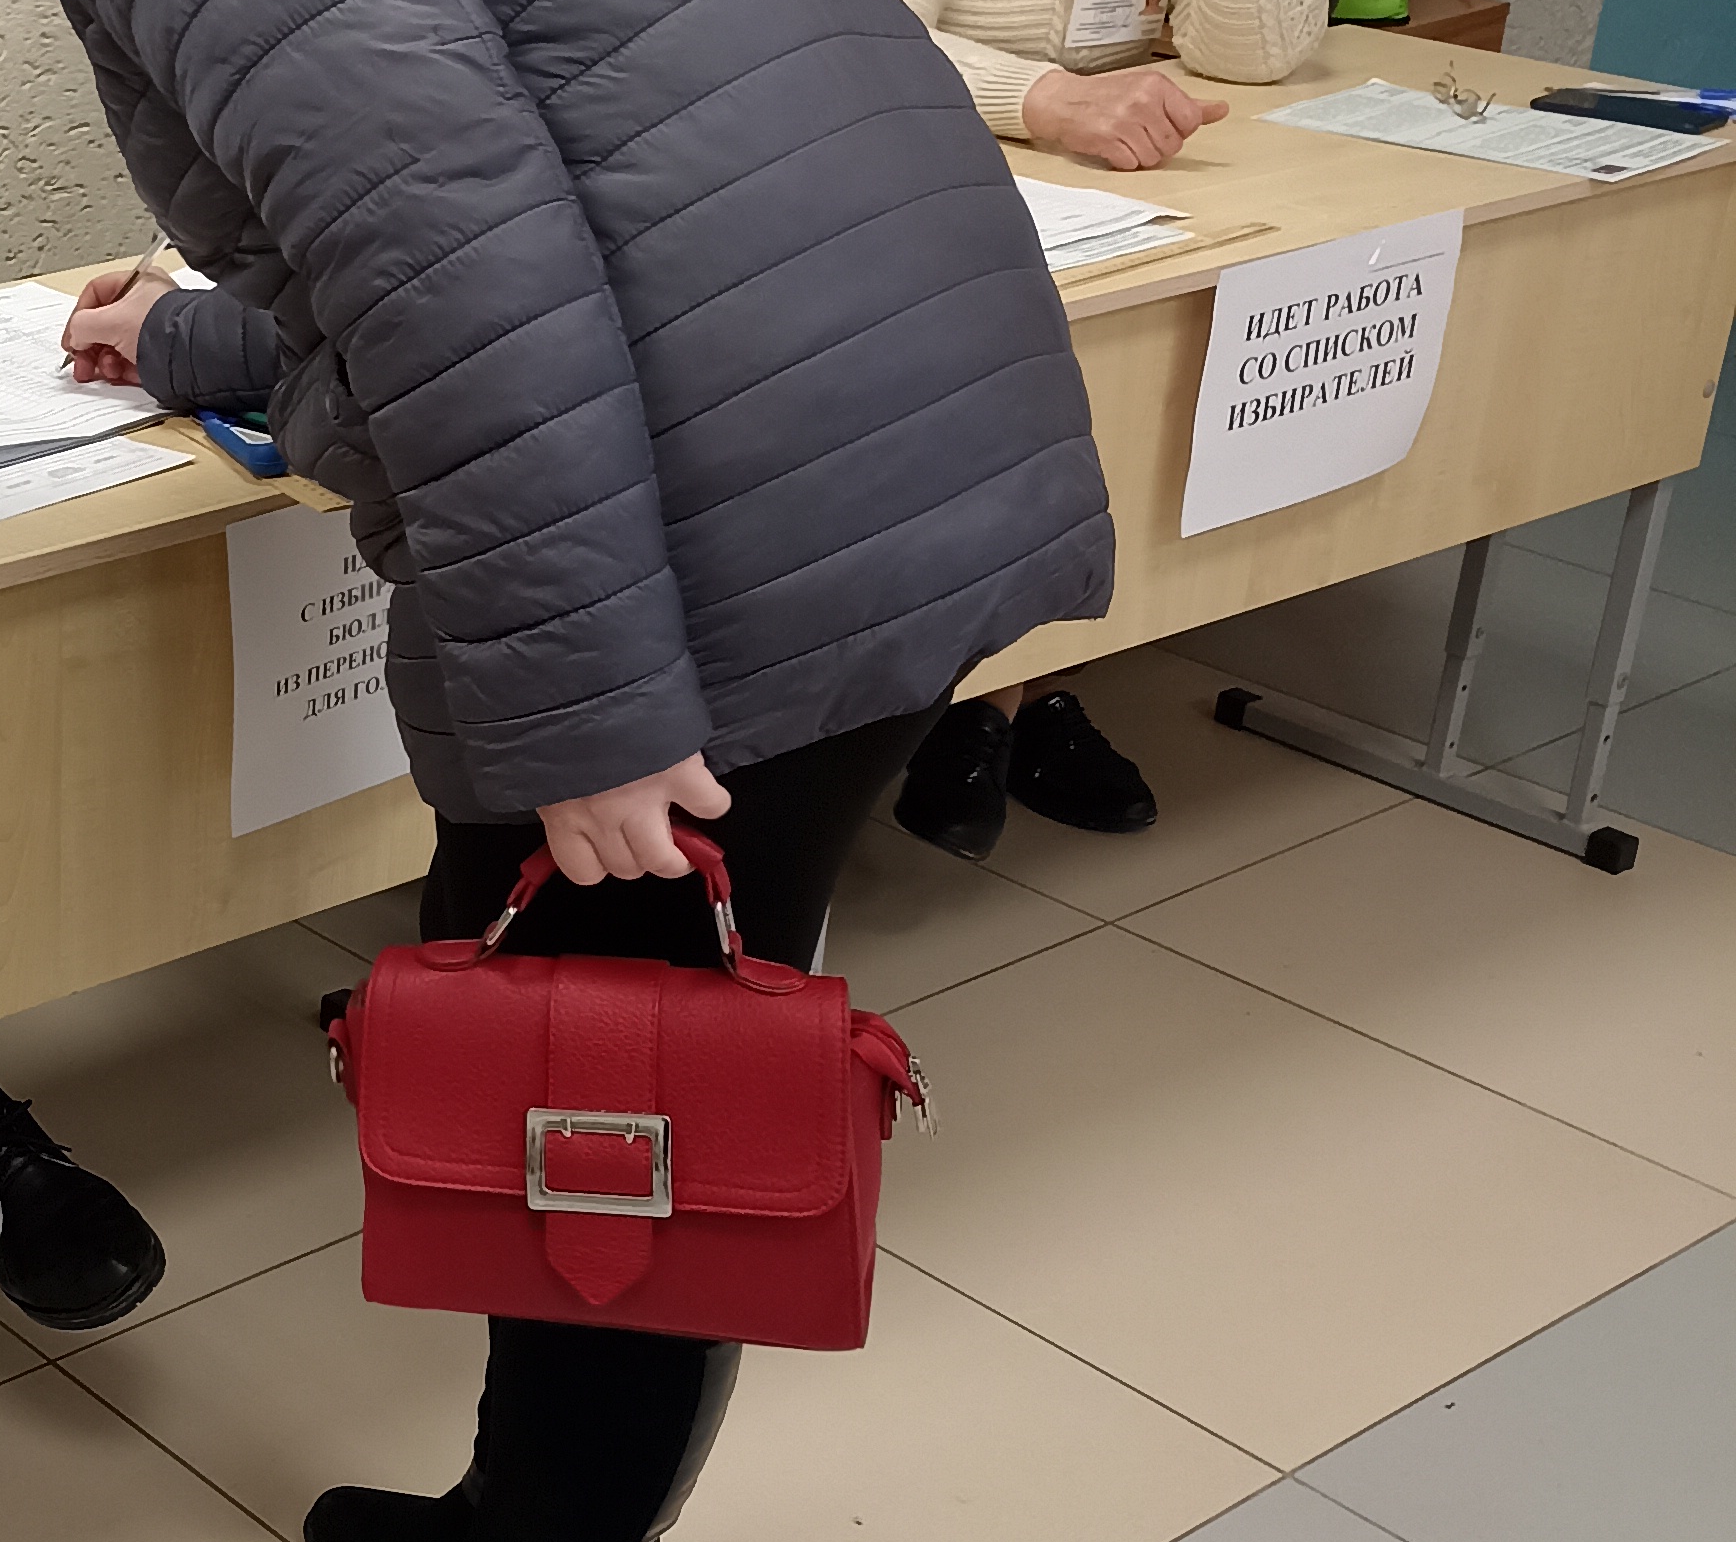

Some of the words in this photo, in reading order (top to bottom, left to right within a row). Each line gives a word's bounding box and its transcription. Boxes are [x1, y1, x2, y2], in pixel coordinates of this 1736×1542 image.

[1245, 297, 1318, 342] ИДЕТ
[1322, 271, 1423, 322] РАБОТА
[1238, 352, 1278, 385] СО
[1284, 312, 1418, 374] СПИСКОМ
[1227, 349, 1415, 432] ИЗБИРАТЕЛЕЙ
[300, 602, 316, 623] С
[320, 577, 391, 617] ИЗБИР
[275, 671, 302, 698] ИЗ
[303, 686, 346, 721] ДЛЯ
[353, 675, 385, 702] ГО
